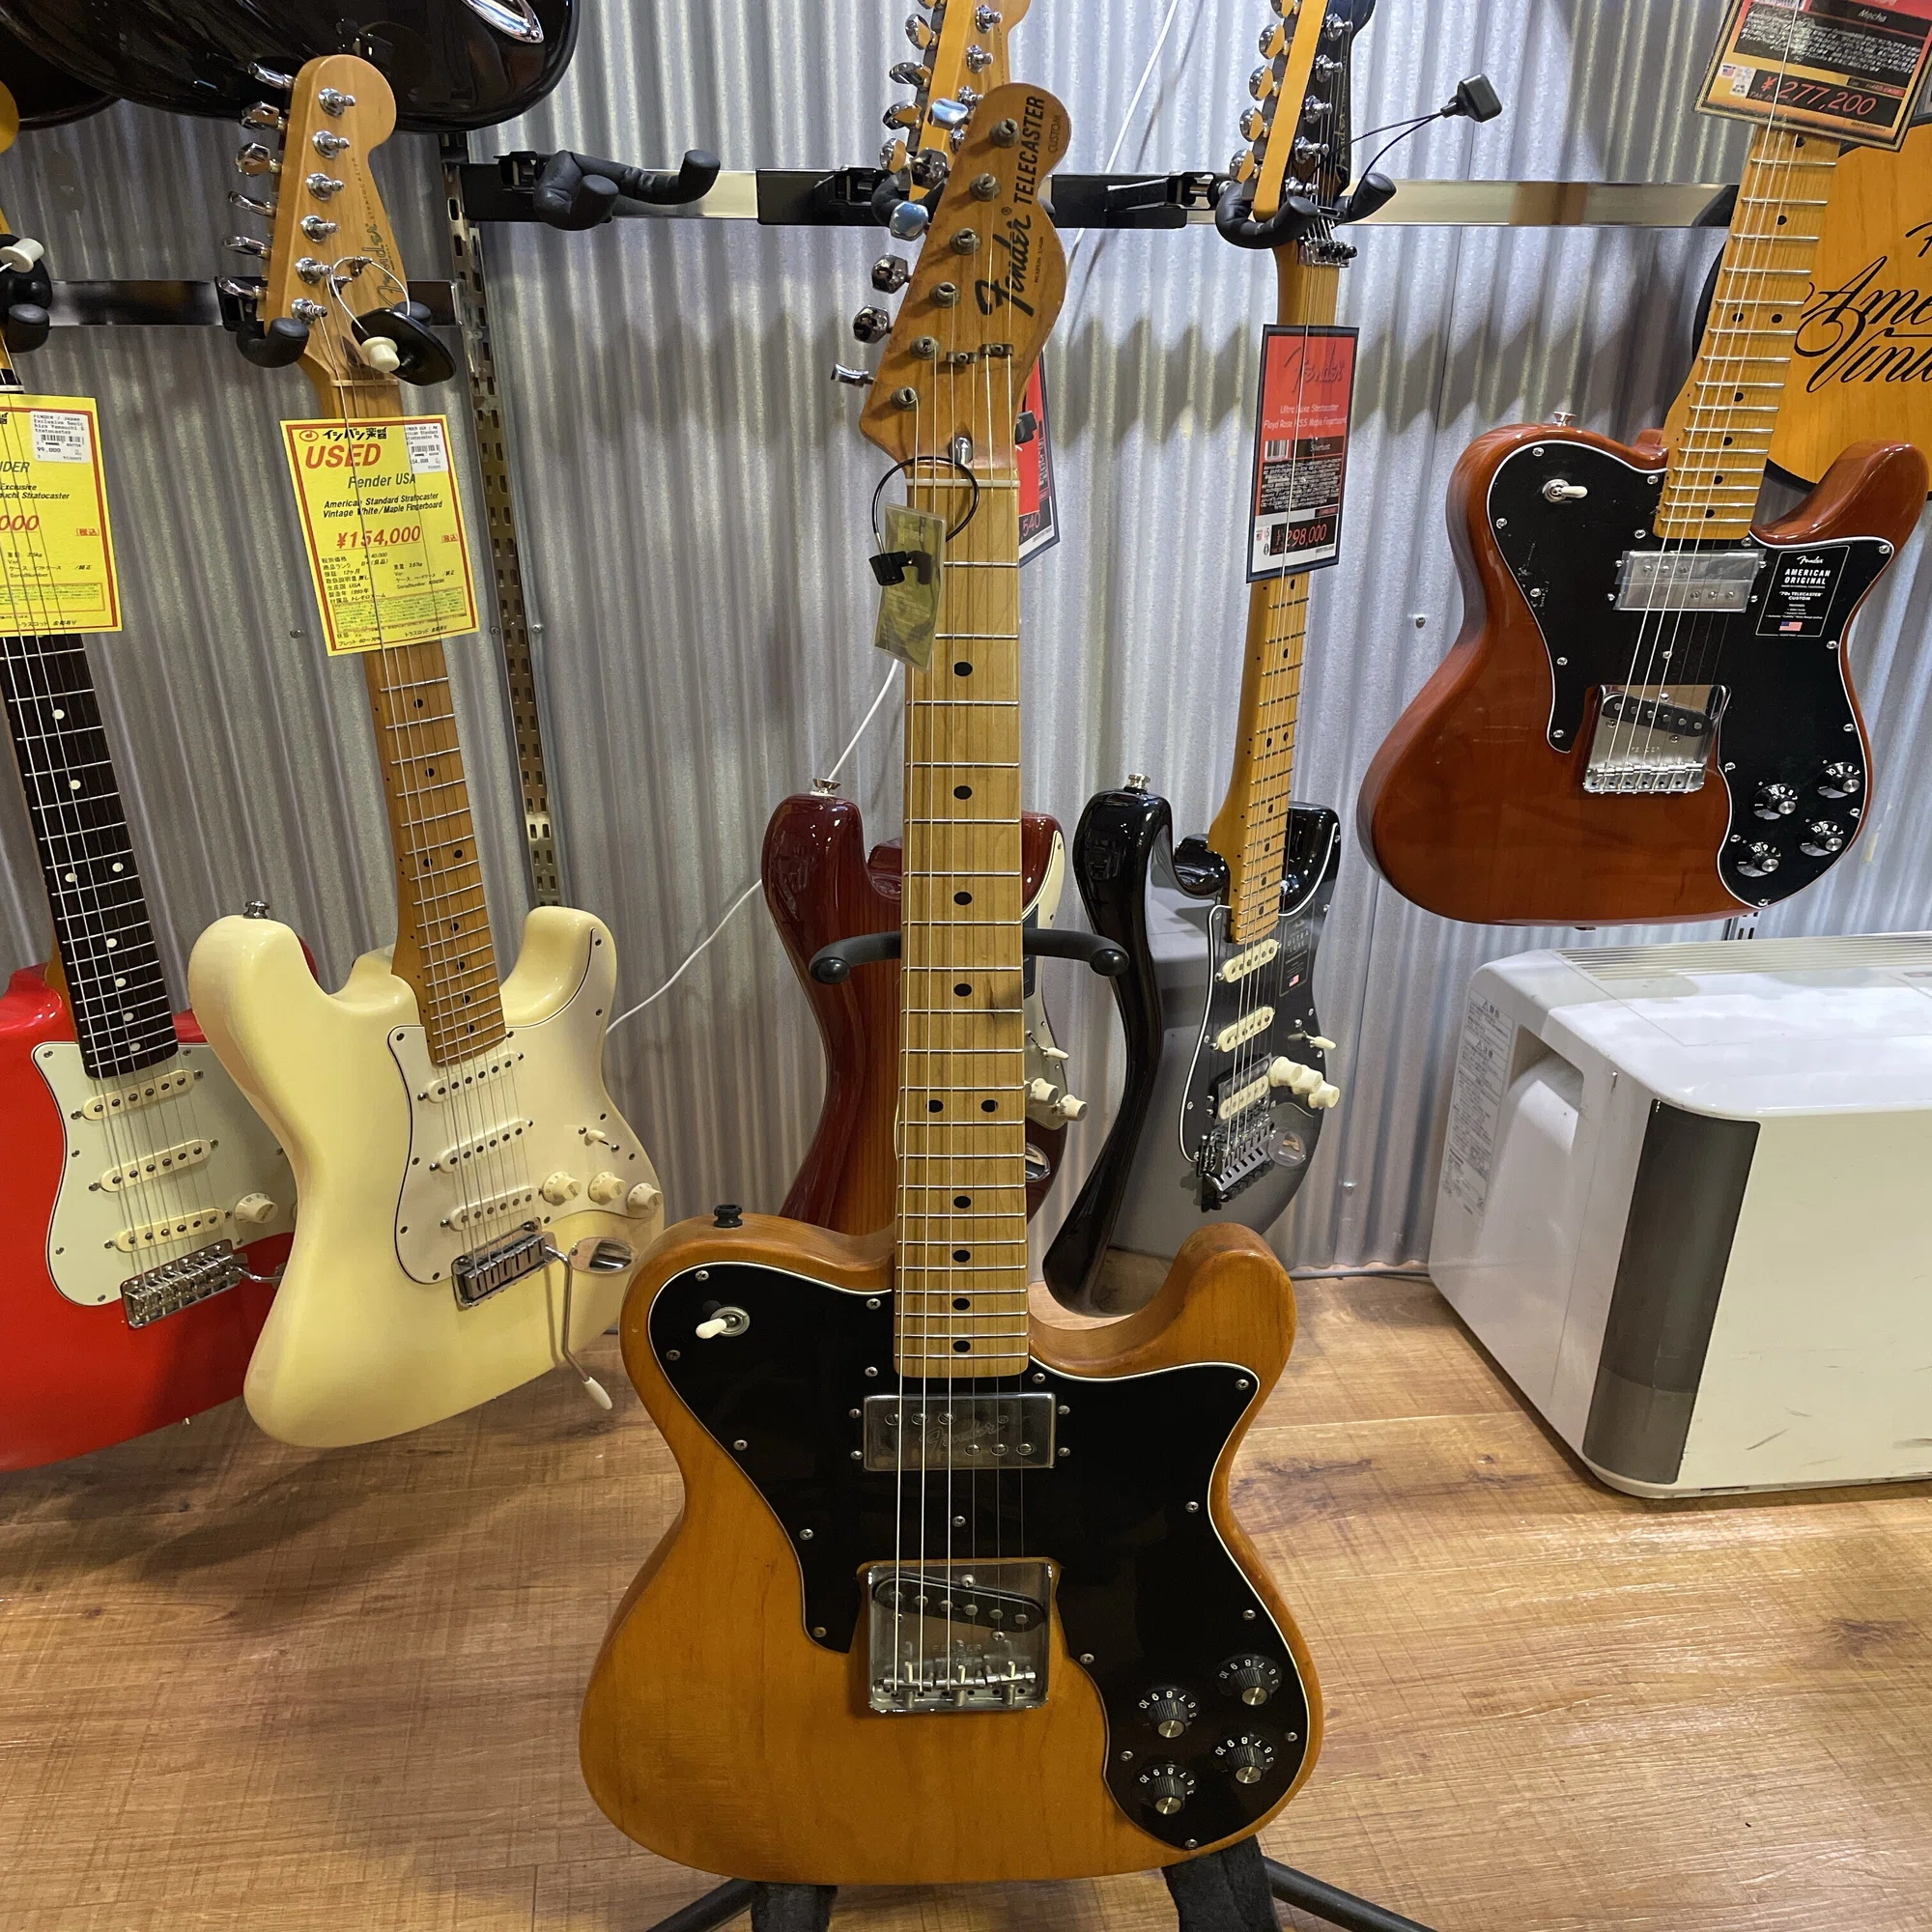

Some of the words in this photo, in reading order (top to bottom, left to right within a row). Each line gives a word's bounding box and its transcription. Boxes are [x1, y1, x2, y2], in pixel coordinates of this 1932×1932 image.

[1859, 9, 1887, 22] Mocha
[1761, 76, 1877, 115] ¥277,200
[1048, 114, 1063, 154] CUSTOM
[974, 213, 1035, 317] Fender
[1014, 96, 1045, 205] TELECASTER
[1284, 341, 1345, 393] Fender
[323, 427, 387, 441] イシバシ楽器
[305, 442, 382, 469] USED
[348, 475, 392, 489] Fender
[396, 472, 416, 486] USA
[323, 507, 354, 518] Vintage
[406, 500, 443, 512] Fingerboard
[324, 498, 363, 509] American
[365, 496, 400, 506] Standard
[401, 492, 440, 503] Stratocaster
[336, 525, 422, 549] ¥154,000
[1797, 555, 1824, 564] Fender
[1784, 568, 1832, 578] AMERICAN
[1784, 577, 1826, 585] ORIGINAL
[919, 1420, 1005, 1455] Fender
[1219, 1670, 1230, 1679] 10
[1244, 1659, 1251, 1667] 8
[1139, 1699, 1150, 1709] 10
[1215, 1747, 1226, 1756] 10
[1241, 1736, 1248, 1745] 8
[1139, 1775, 1150, 1783] 10
